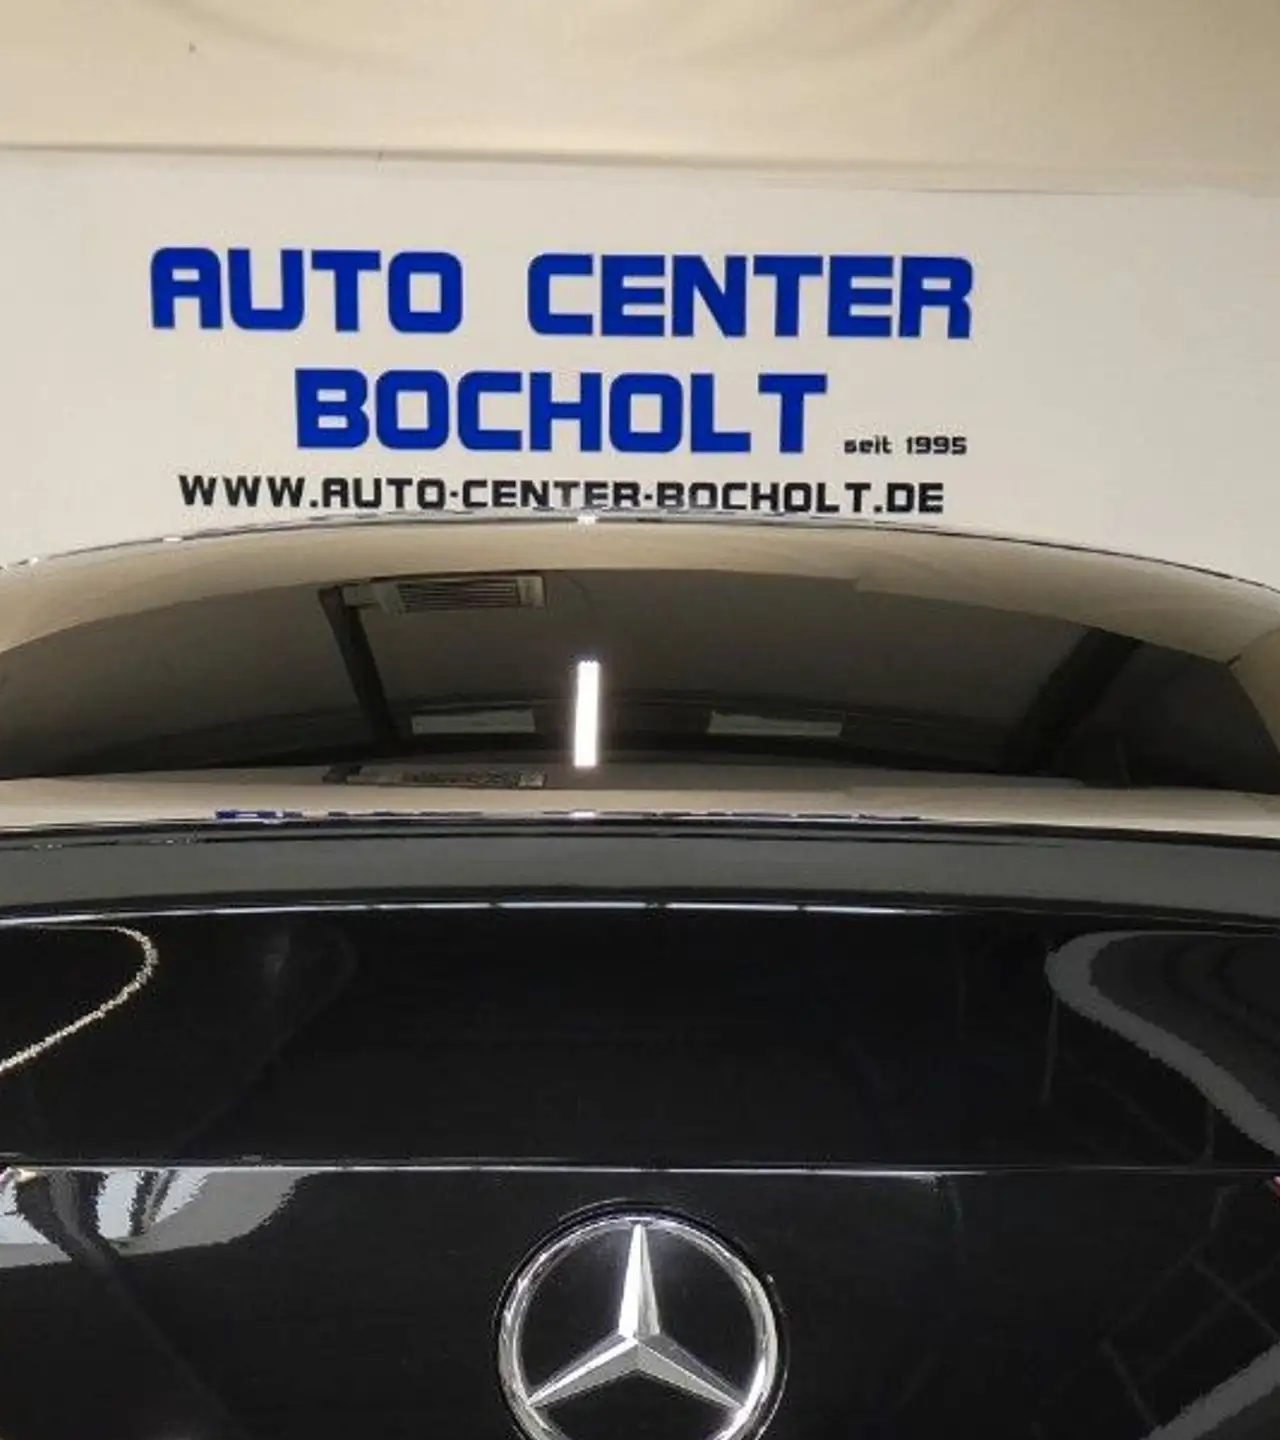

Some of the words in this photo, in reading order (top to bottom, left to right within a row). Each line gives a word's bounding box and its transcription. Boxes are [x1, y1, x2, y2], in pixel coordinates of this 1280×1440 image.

[151, 247, 462, 332] AUTO
[528, 254, 974, 339] CENTER
[295, 368, 827, 453] BOCHOLT
[843, 436, 892, 455] seit
[906, 436, 967, 455] 1995
[178, 475, 944, 514] WWW.AUTO-CENTER-BOCHOLT.DE
